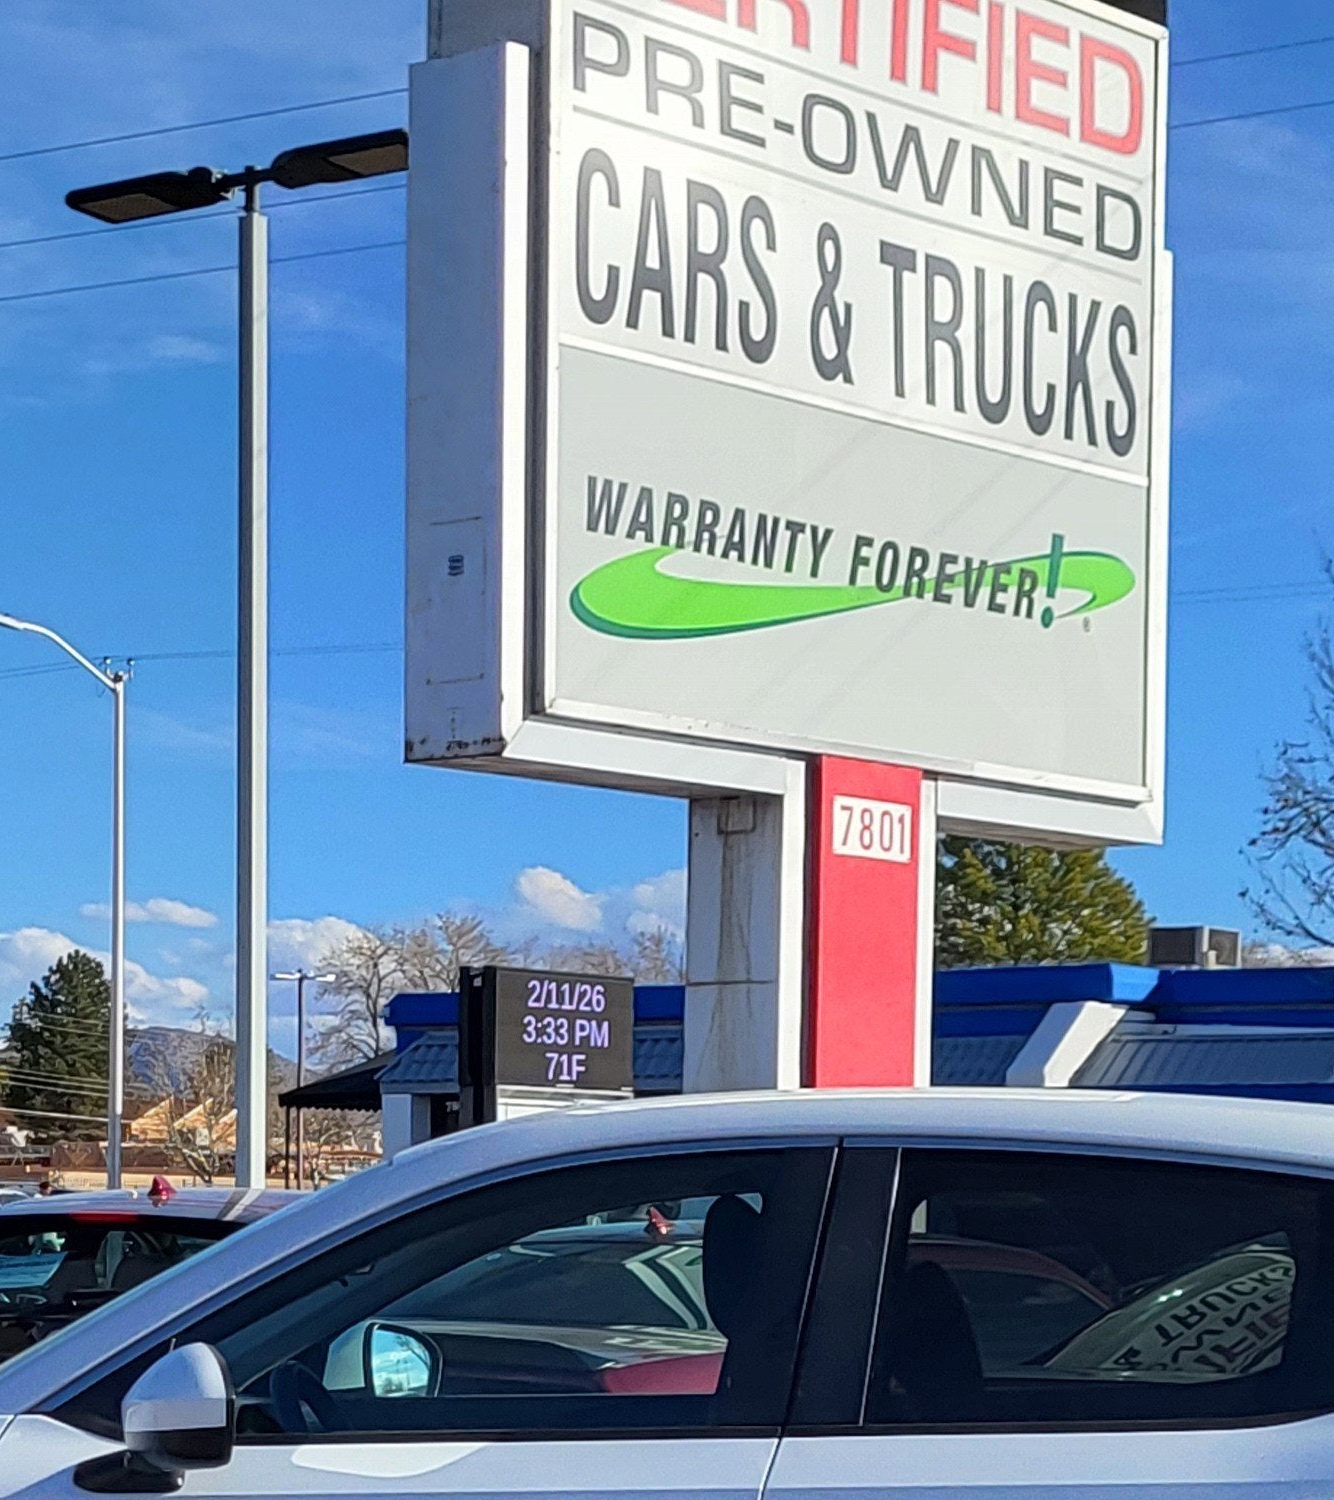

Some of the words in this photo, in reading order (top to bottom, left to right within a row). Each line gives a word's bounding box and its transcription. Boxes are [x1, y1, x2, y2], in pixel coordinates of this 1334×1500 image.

[660, 0, 1144, 155] IFIED
[572, 10, 1143, 262] PRE-OWNED
[575, 147, 777, 364] CARS
[810, 221, 855, 386] &
[879, 238, 1139, 457] TRUCKS
[585, 475, 835, 579] WARRANTY
[848, 532, 1065, 629] FOREVER!
[839, 804, 906, 855] 7801
[521, 1014, 569, 1046] 3:33
[573, 1018, 610, 1049] PM
[527, 979, 606, 1012] 2/11/26
[544, 1052, 587, 1081] 71F
